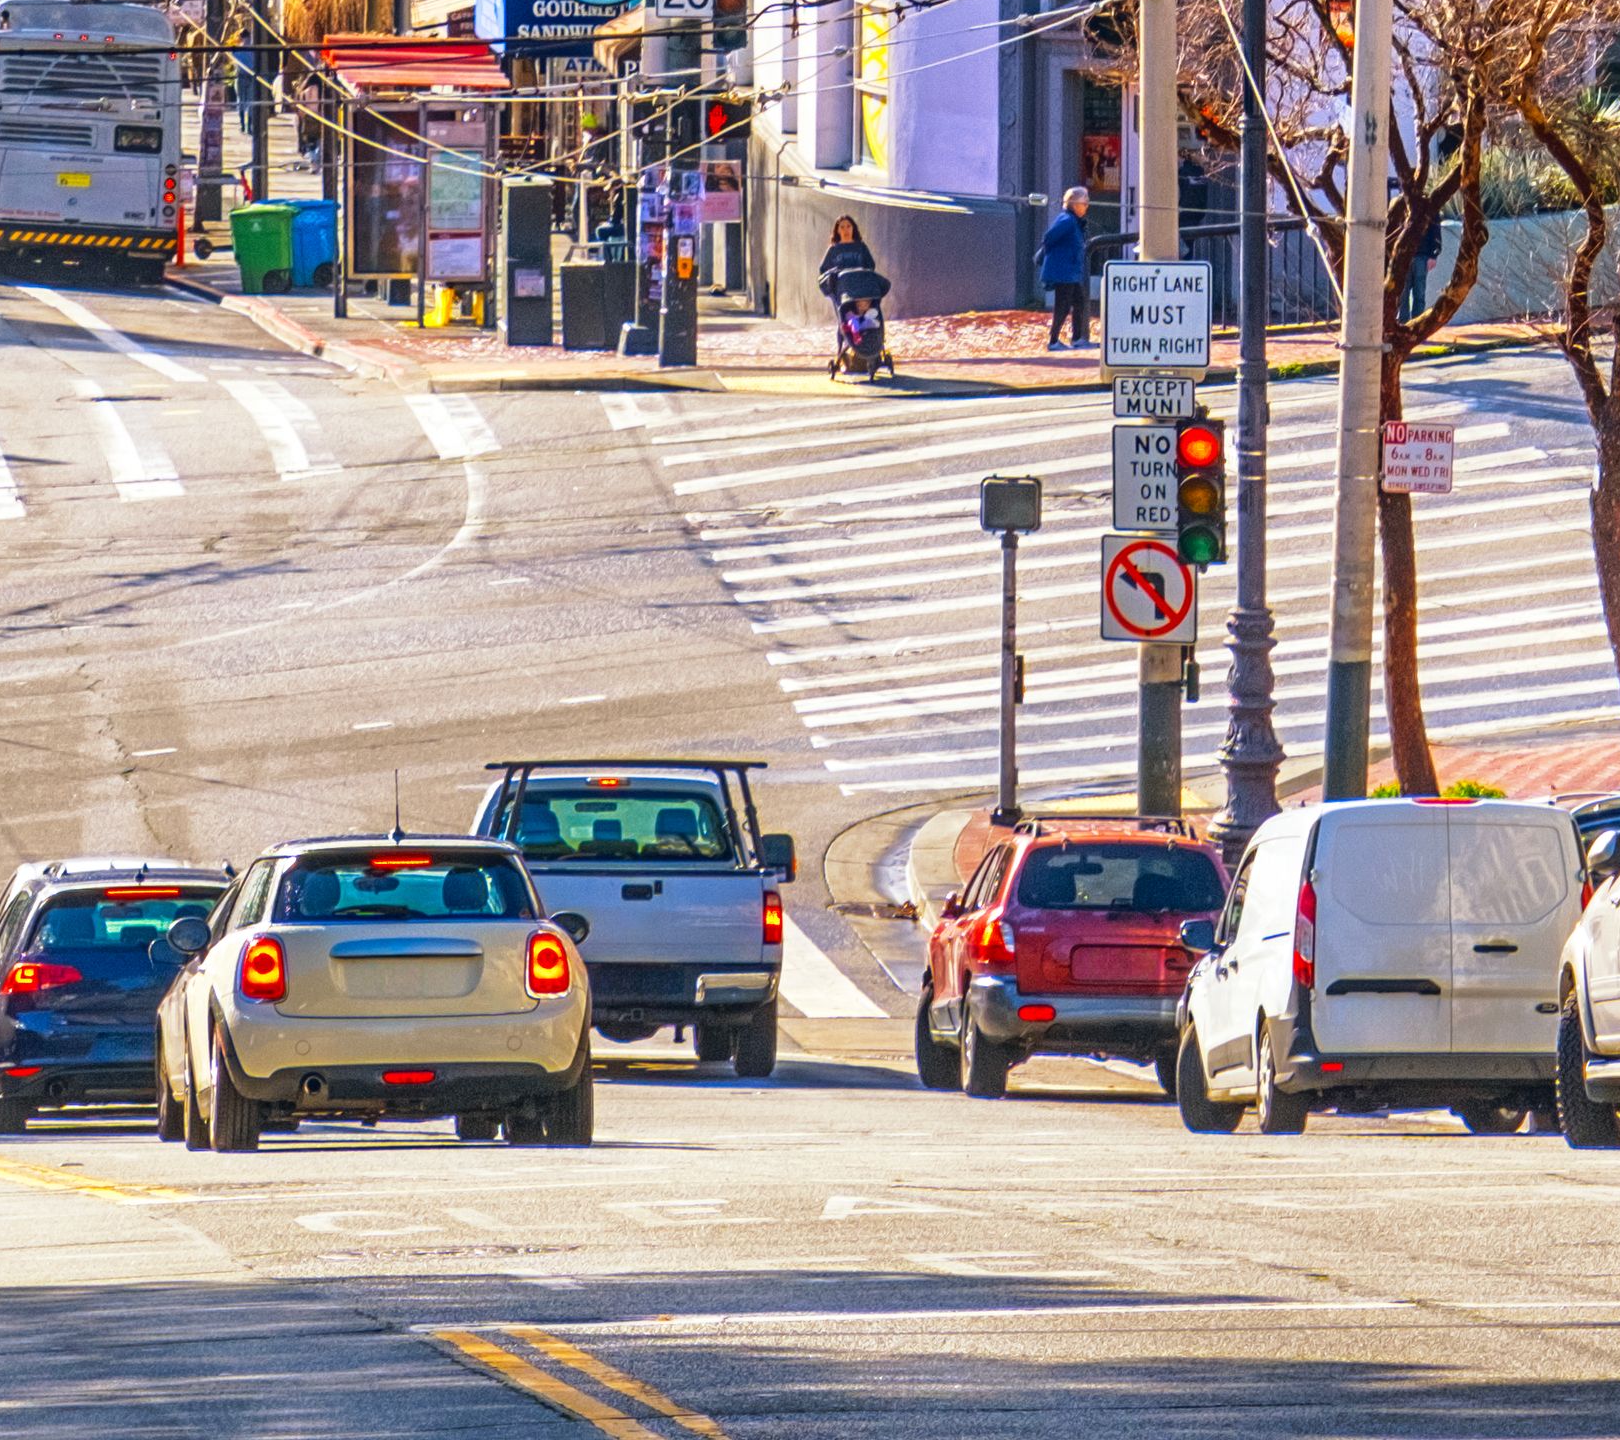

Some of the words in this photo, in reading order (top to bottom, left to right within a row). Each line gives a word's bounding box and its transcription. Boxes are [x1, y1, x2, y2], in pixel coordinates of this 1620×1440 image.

[1112, 276, 1157, 292] RIGHT
[1164, 277, 1204, 293] LANE
[1130, 305, 1185, 325] MUST
[1111, 337, 1151, 353] TURN
[1159, 338, 1204, 354] RIGHT
[1120, 380, 1187, 397] EXCEPT
[1126, 398, 1182, 414] MUNI
[1386, 424, 1405, 442] NO
[1408, 430, 1452, 443] PARKING
[1135, 436, 1170, 454] NO
[1130, 461, 1178, 477] TURN
[1387, 466, 1407, 476] MON
[1411, 466, 1430, 477] WED
[1434, 467, 1449, 478] FRI
[1140, 484, 1166, 499] ON
[1136, 506, 1170, 522] RED
